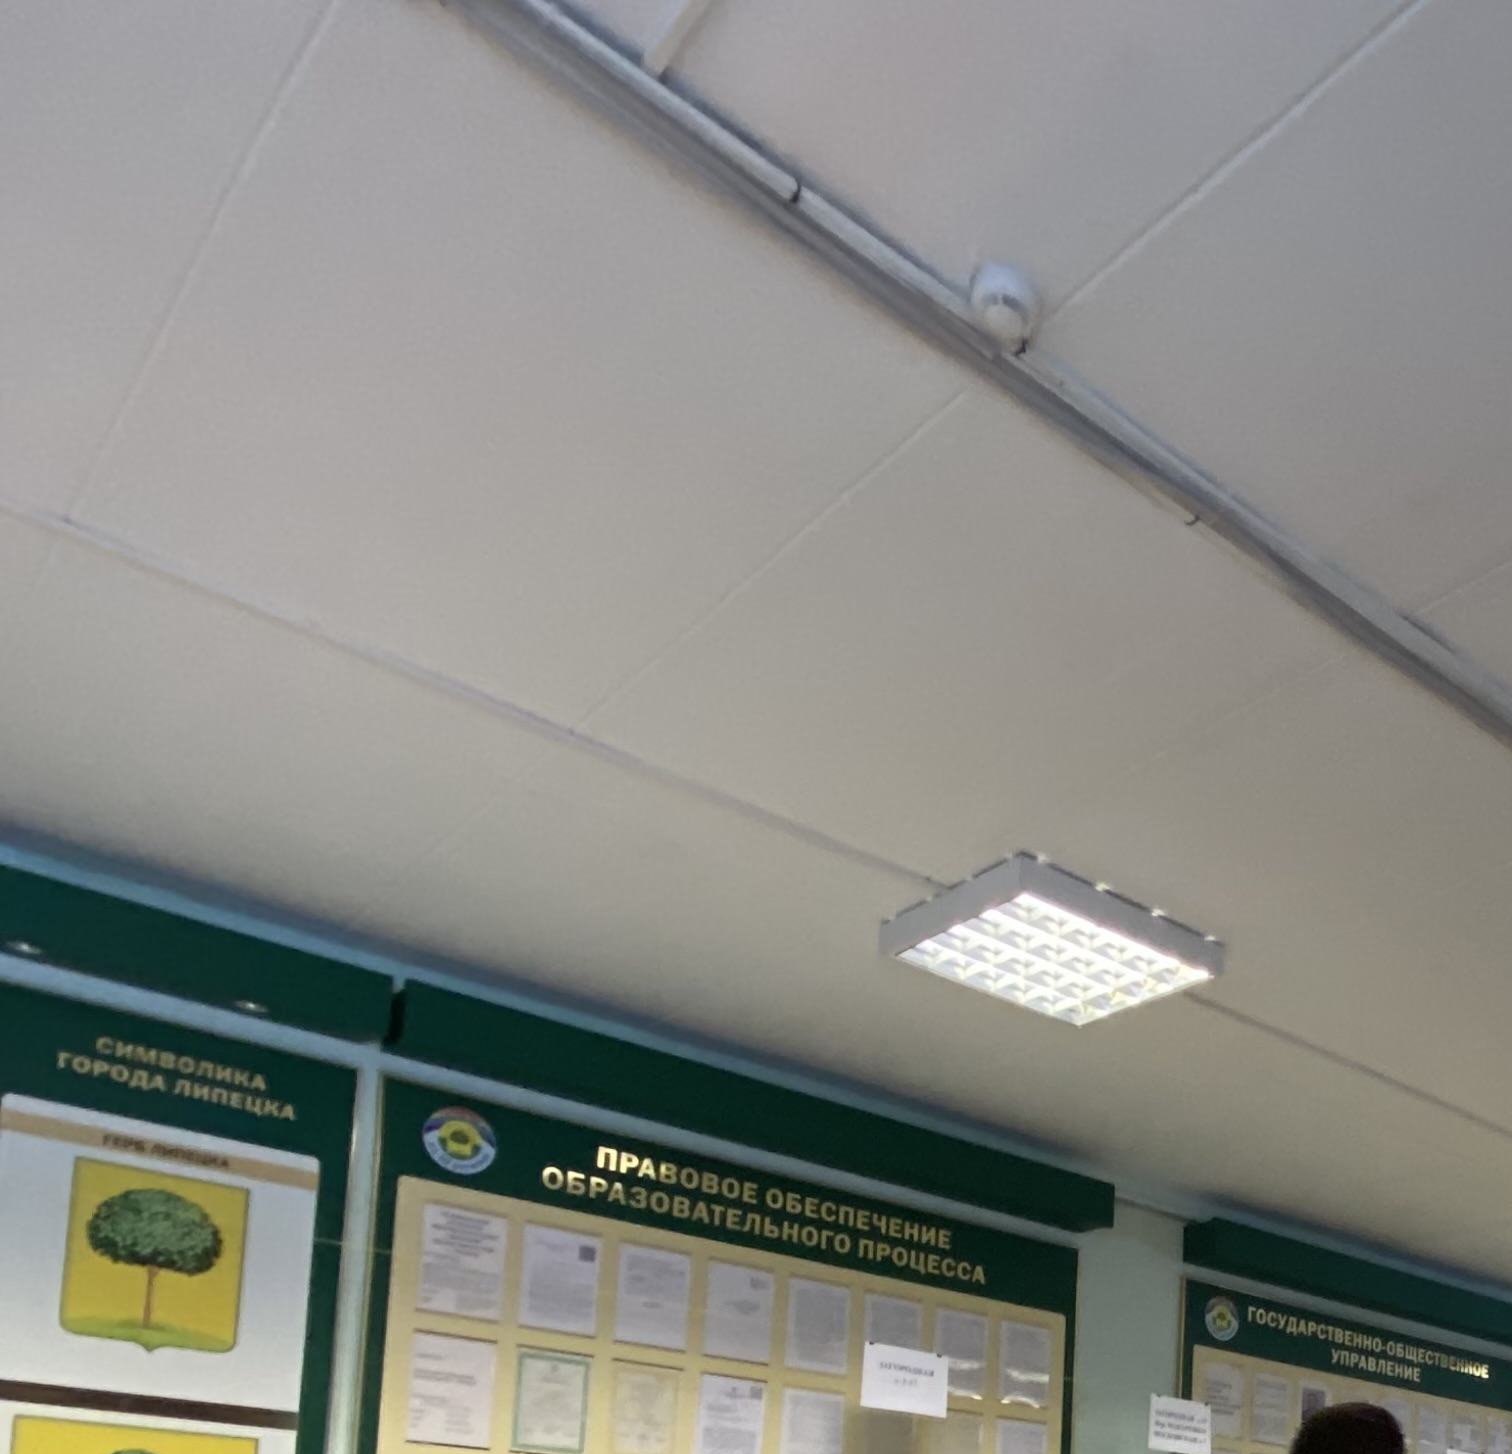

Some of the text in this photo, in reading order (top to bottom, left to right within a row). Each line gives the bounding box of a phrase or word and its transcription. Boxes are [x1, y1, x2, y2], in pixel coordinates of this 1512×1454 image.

[57, 1052, 296, 1121] ГОРОДА ЛИПЕЦКА
[95, 1036, 267, 1091] СИМВОЛИКА
[541, 1166, 986, 1285] ОБРАЗОВАТЕЛЬНОГО ПРОЦЕССА
[596, 1146, 952, 1249] ПРАВОВОЕ ОБЕСПЕЧЕНИЕ
[1247, 1306, 1489, 1380] ГОСУДАРСТВЕННО-ОБЩЕСТВЕННОЕ
[1331, 1348, 1421, 1383] УПРАВЛЕНИЕ
